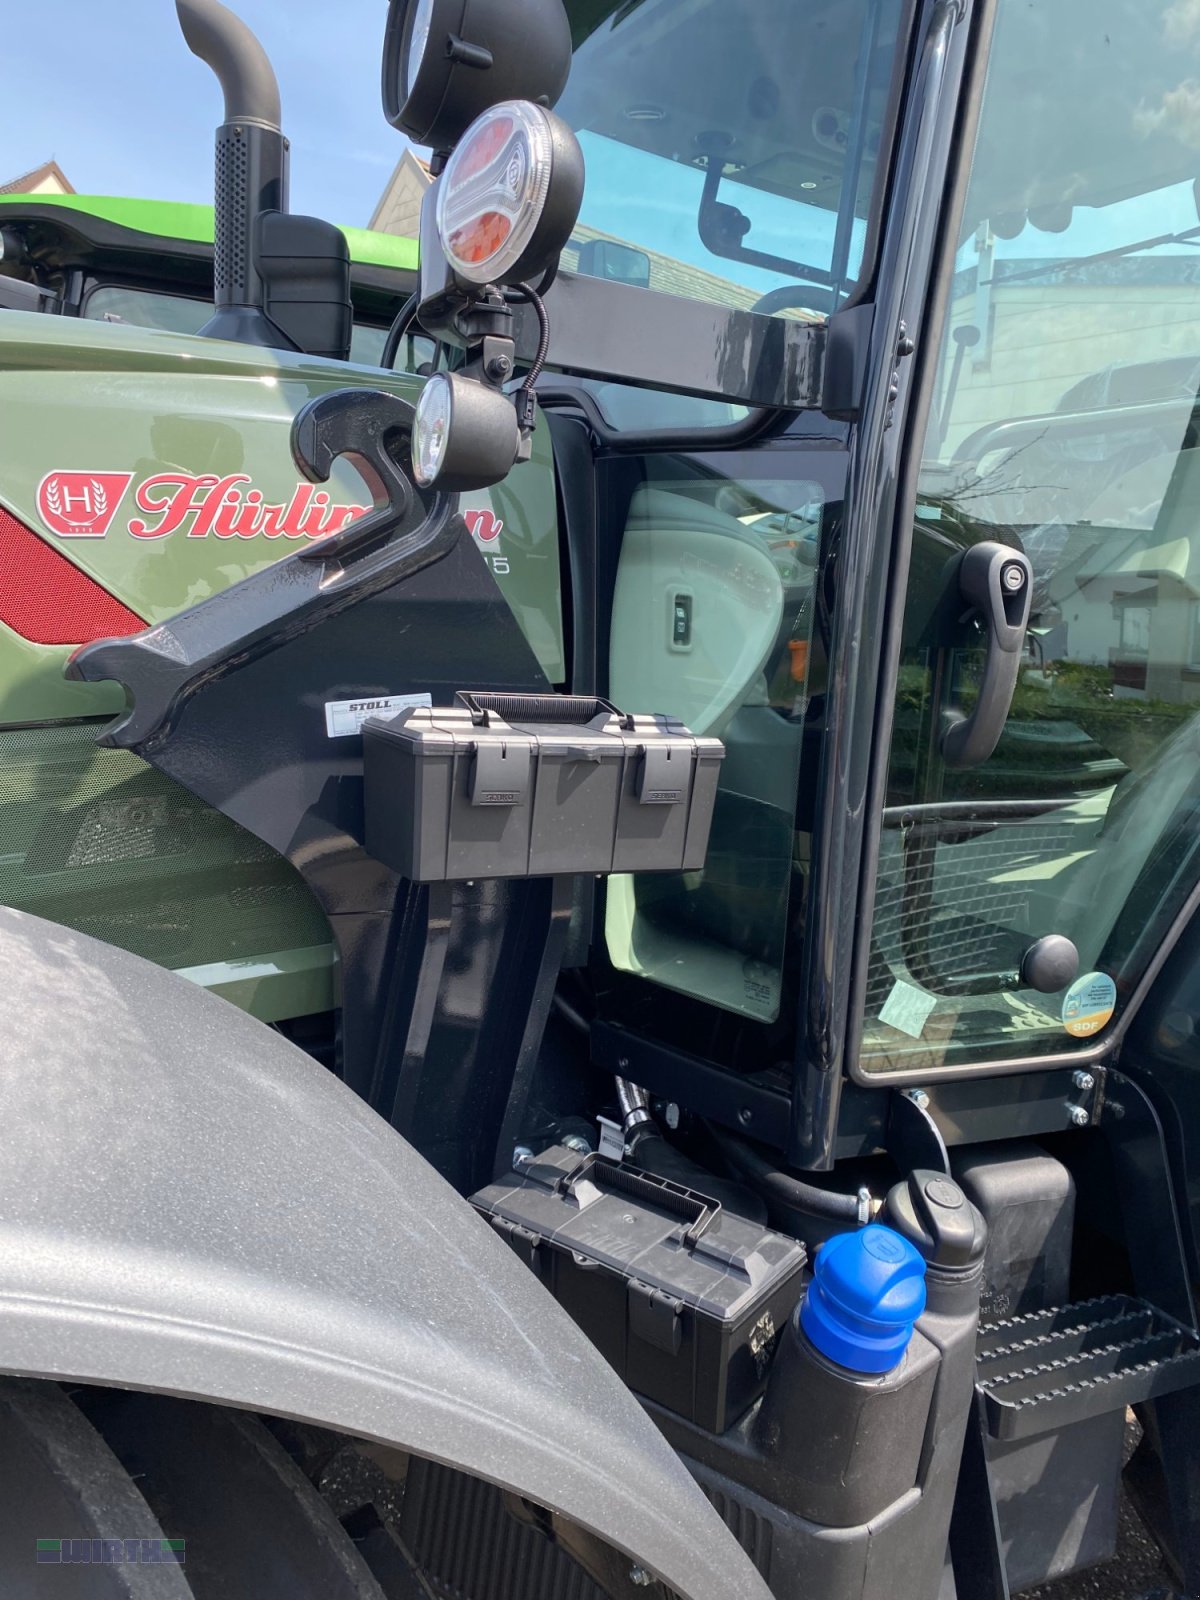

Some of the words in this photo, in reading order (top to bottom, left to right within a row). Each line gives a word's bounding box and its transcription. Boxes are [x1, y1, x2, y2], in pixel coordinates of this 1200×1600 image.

[63, 485, 92, 512] H
[129, 474, 503, 540] Hürlin
[349, 701, 392, 712] STOLL
[1072, 1022, 1099, 1032] SDF
